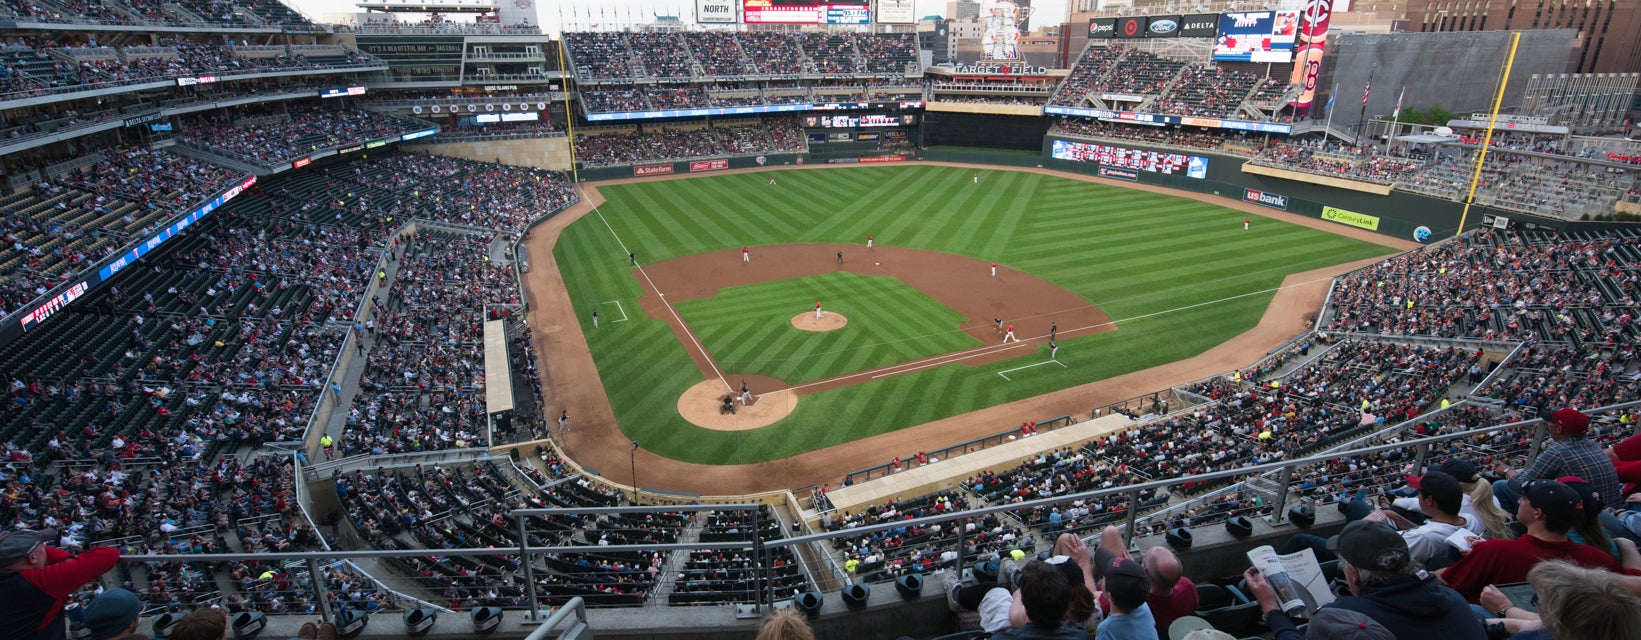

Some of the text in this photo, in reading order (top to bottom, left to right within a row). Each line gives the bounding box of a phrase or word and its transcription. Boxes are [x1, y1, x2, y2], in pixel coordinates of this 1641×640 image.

[704, 5, 729, 13] NORTH
[1097, 24, 1114, 32] pepsi
[1154, 23, 1172, 31] Ford
[955, 66, 1047, 74] TARGET FIELD
[1338, 213, 1373, 226] CenturyLink
